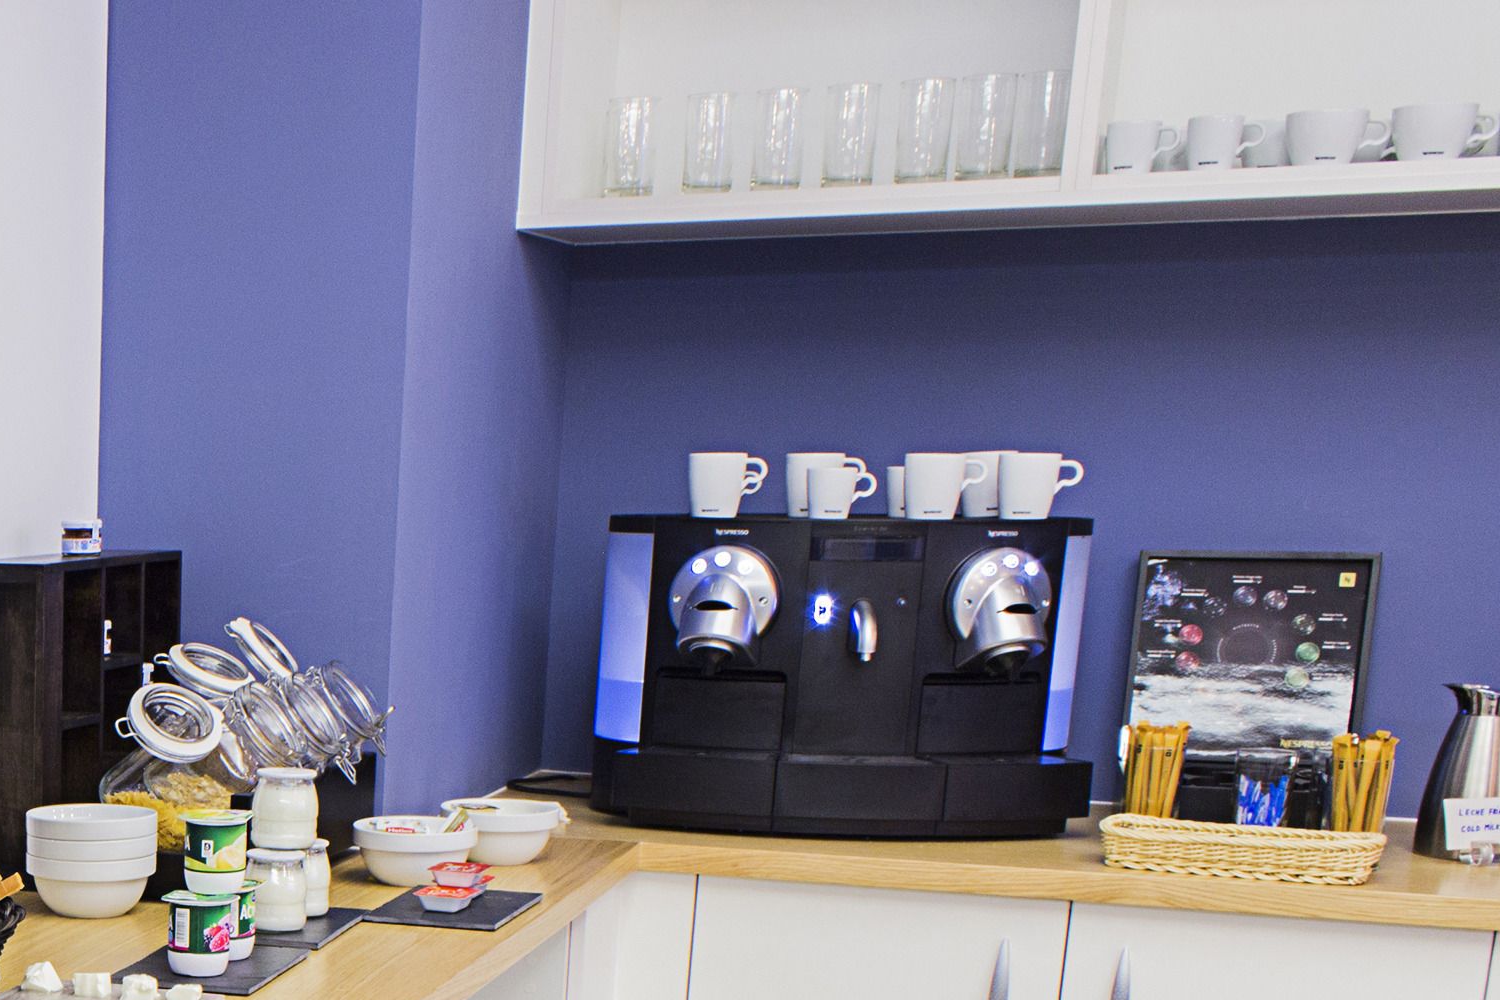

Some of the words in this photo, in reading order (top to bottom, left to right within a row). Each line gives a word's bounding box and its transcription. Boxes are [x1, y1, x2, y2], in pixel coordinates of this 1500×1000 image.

[715, 528, 750, 536] NESPRESSO
[1458, 808, 1485, 817] LECHE
[1460, 825, 1481, 833] COLD
